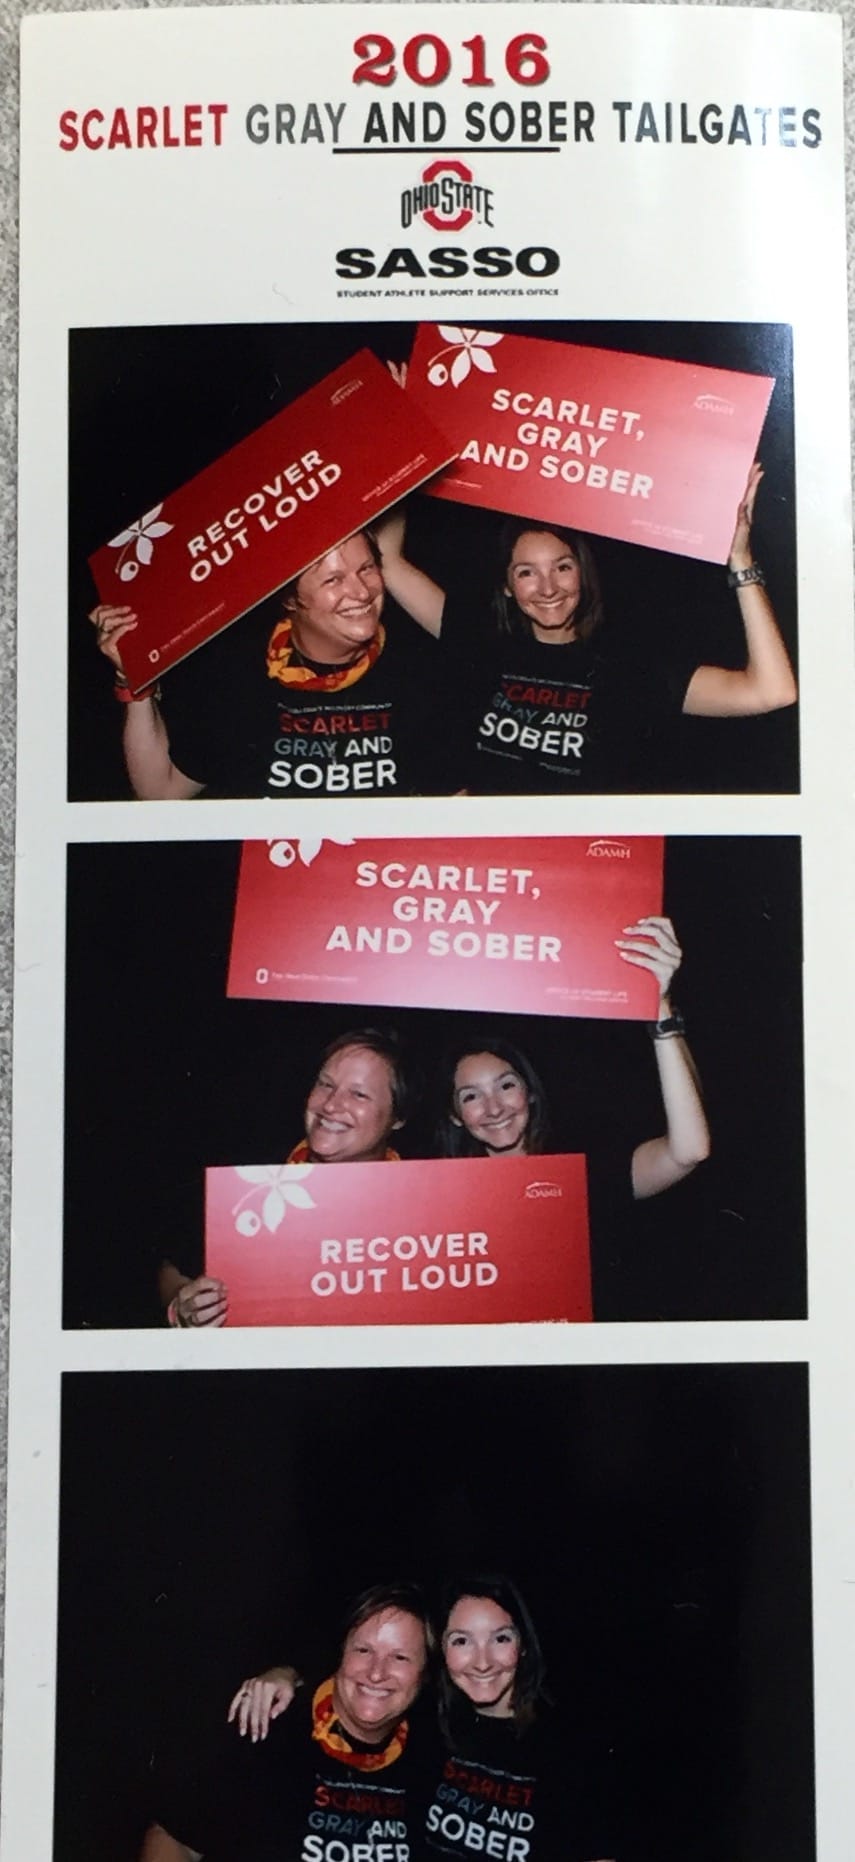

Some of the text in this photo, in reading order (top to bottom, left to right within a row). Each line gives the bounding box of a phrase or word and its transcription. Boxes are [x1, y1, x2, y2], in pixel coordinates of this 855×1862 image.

[352, 33, 551, 87] 2016
[58, 101, 823, 151] SCARLET GRAY AND SOBER TAILGATES
[401, 177, 494, 229] OHIO STATE
[335, 246, 561, 279] SASSO
[336, 289, 382, 298] STUDENT
[428, 288, 474, 297] SUPPORT
[477, 288, 524, 296] SERVICES
[526, 288, 559, 296] OFFICE
[491, 388, 646, 441] SCARLET,
[517, 423, 607, 459] GRAY
[460, 439, 655, 499] AND SOBER
[187, 449, 325, 558] RECOVER
[189, 530, 250, 584] OUT
[259, 462, 342, 532] LOUD
[279, 712, 391, 735] SCARLET
[479, 712, 584, 758] SOBER
[540, 711, 588, 729] AND
[274, 736, 393, 758] GRAY AND
[267, 760, 397, 792] SOBER
[586, 846, 631, 859] ADAMH
[355, 861, 541, 901] SCARLET,
[392, 897, 501, 926] GRAY
[325, 926, 562, 962] AND SOBER
[320, 1232, 489, 1265] RECOVER
[311, 1263, 498, 1297] OUT LOUD
[308, 1811, 407, 1840] GRAY AND
[436, 1783, 485, 1815] GRAY
[487, 1806, 535, 1832] AND
[425, 1804, 531, 1862] SOBER
